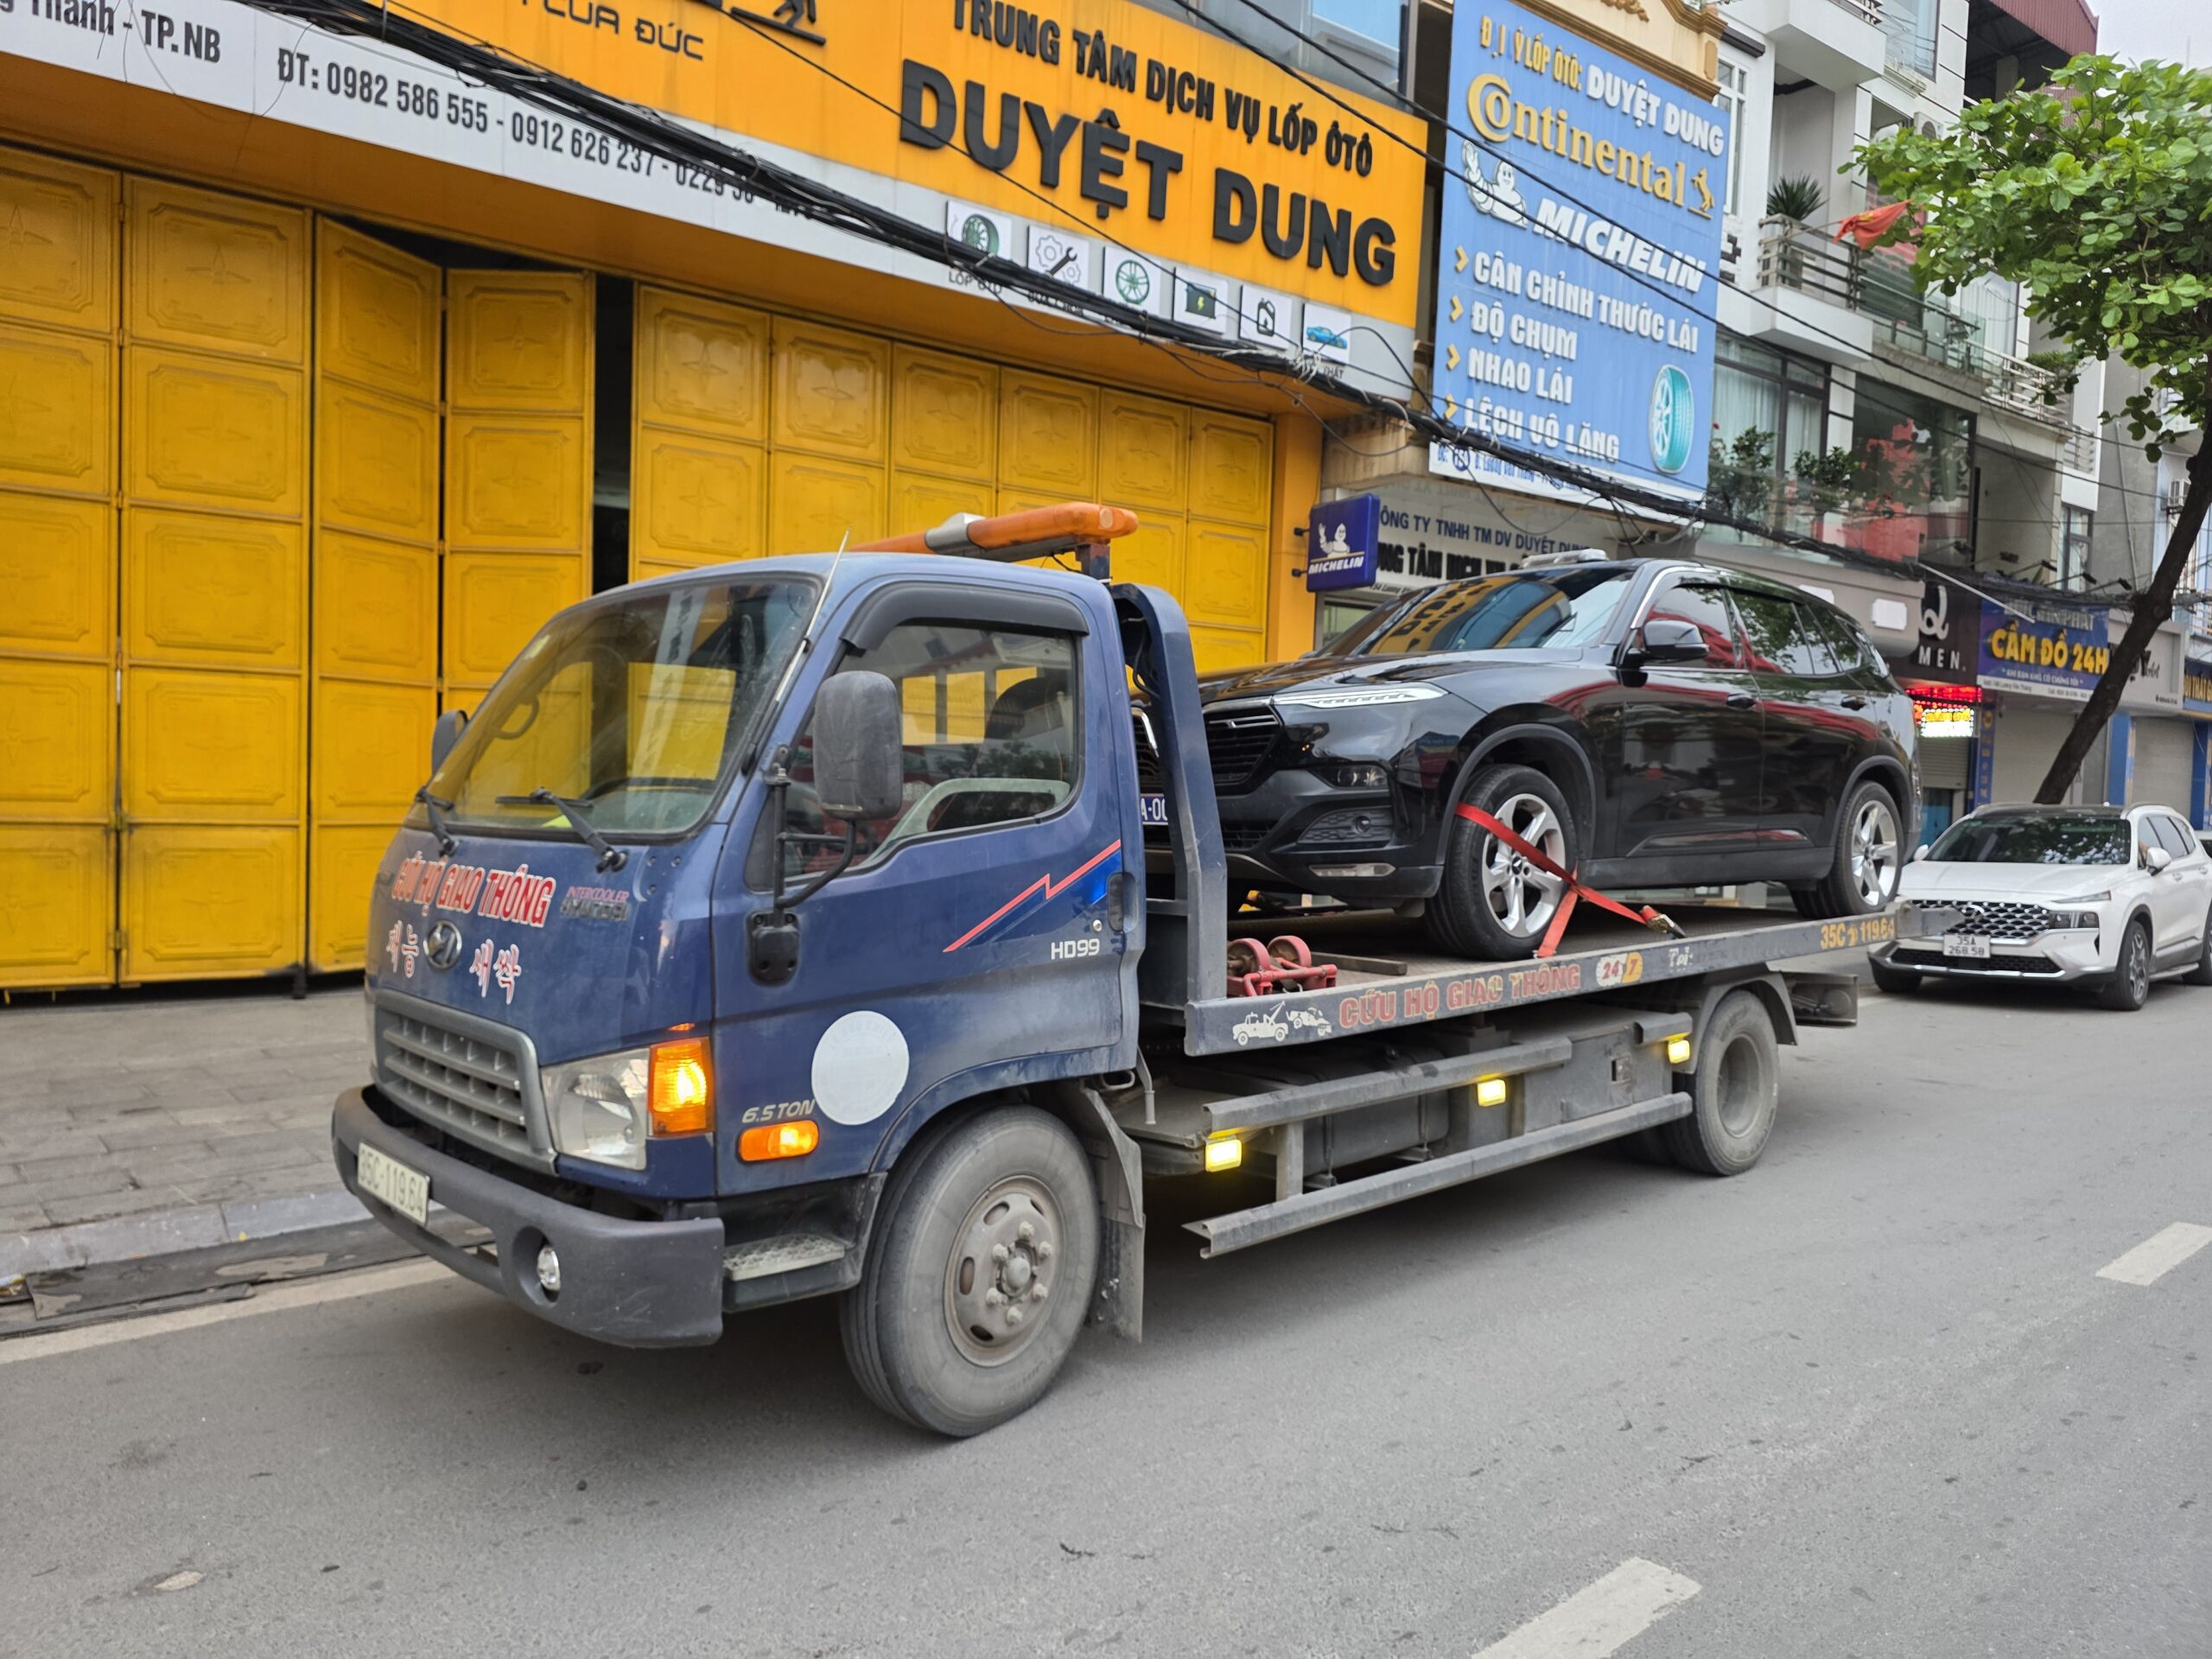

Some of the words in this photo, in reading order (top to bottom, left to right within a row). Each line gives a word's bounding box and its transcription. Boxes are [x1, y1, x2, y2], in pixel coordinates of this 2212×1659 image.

[277, 48, 319, 89] ĐT:
[327, 62, 388, 108] 0982
[397, 80, 439, 120] 586
[446, 93, 488, 133] 555
[512, 111, 563, 153] 0912
[570, 128, 610, 165] 626
[1072, 30, 1137, 92] TÂM
[1147, 59, 1215, 122] DỊCH
[1224, 87, 1261, 143] VỤ
[1268, 102, 1318, 155] LỐP
[1325, 120, 1372, 176] ÔTÔ
[1586, 64, 1661, 127] DUYỆT
[1663, 101, 1725, 156] DUNG
[1468, 73, 1685, 207] Continental
[899, 58, 1183, 219] DUYỆT
[1213, 168, 1395, 287] DUNG
[1533, 197, 1707, 293] MICHELIN
[1471, 301, 1504, 344] ĐỘ
[1510, 315, 1578, 360] CHỤM
[1474, 251, 1522, 296] CÂN
[1526, 270, 1593, 320] CHỈNH
[1598, 295, 1664, 342] THƯỚC
[1667, 318, 1699, 353] LÁI
[1468, 348, 1531, 392] NHAO
[1535, 366, 1573, 404] LÁI
[1565, 422, 1620, 463] LĂNG
[1380, 505, 1409, 530] ÔNG
[1413, 515, 1431, 532] TY
[1436, 519, 1470, 540] TNHH
[1474, 526, 1492, 544] TM
[1496, 531, 1512, 547] DV
[1308, 556, 1364, 575] MICHELIN
[1991, 620, 2036, 664] CẦM
[2072, 643, 2109, 675] 24H
[436, 863, 486, 914] GIAO
[478, 863, 556, 928] THÔNG
[1051, 938, 1100, 960] HD99
[1820, 921, 1847, 950] 35C
[1404, 979, 1439, 1020] HỘ
[1509, 963, 1581, 1000] THÔNG
